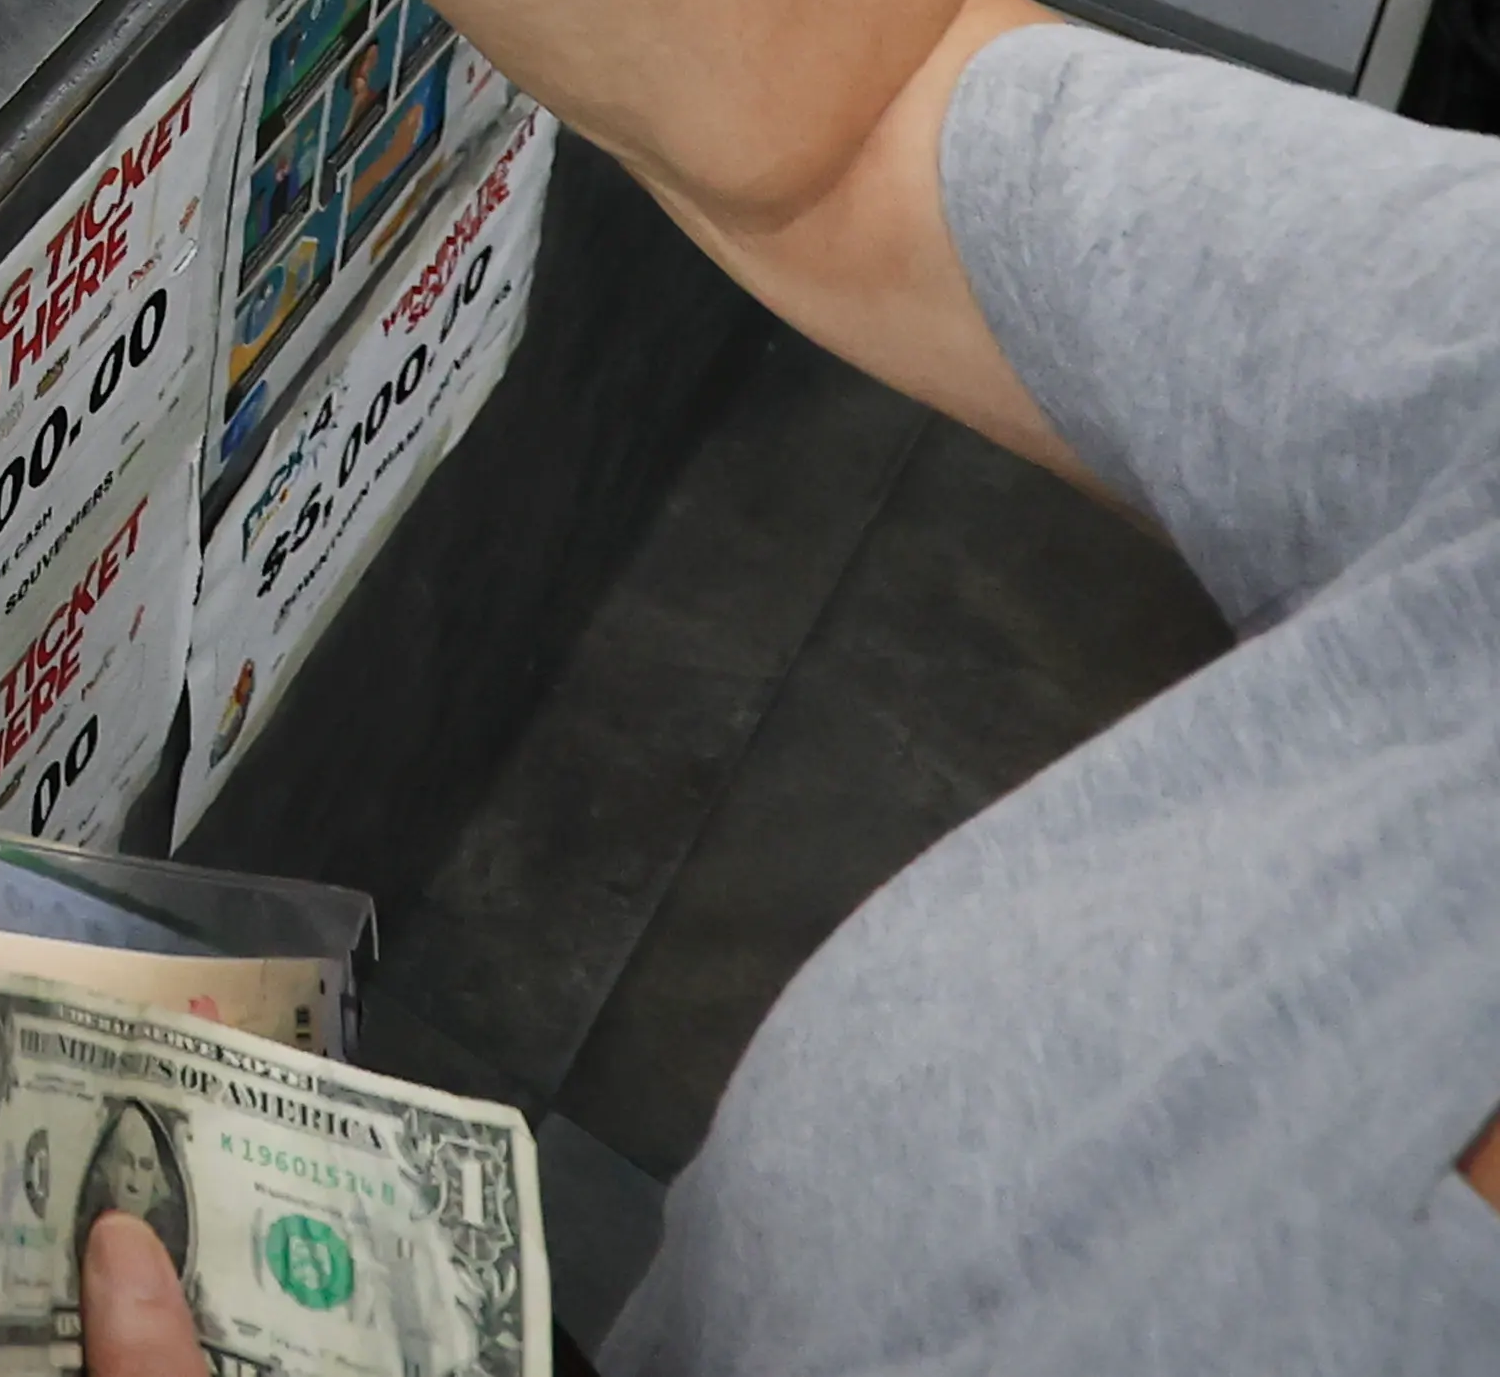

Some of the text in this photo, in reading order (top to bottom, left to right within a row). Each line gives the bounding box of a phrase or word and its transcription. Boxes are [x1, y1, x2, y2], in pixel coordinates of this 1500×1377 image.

[44, 85, 197, 270] TICKET
[8, 198, 133, 390] HERE
[222, 1082, 385, 1151] AMERICA
